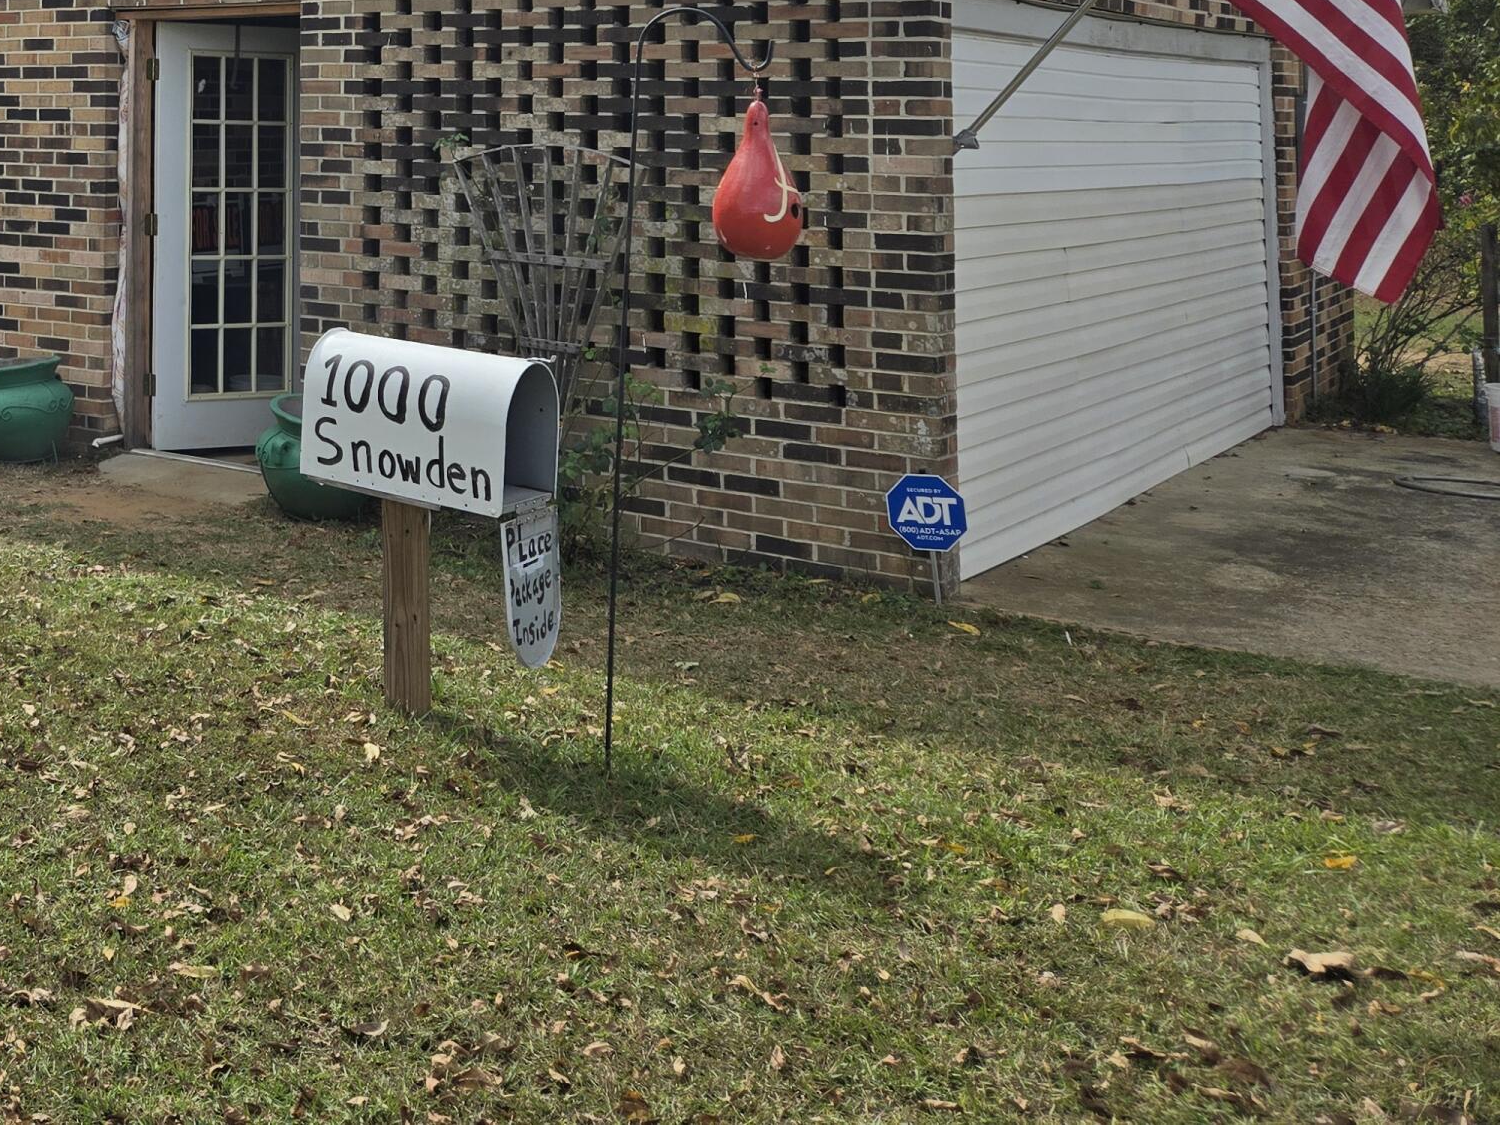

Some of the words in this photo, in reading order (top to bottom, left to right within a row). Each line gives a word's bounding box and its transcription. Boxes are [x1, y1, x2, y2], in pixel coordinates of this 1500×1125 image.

[320, 354, 450, 432] 1000
[314, 417, 492, 502] Snowden
[896, 496, 957, 526] ADT
[919, 527, 962, 537] ADT-ASAP
[509, 569, 552, 607] Package
[513, 609, 554, 646] Inside
